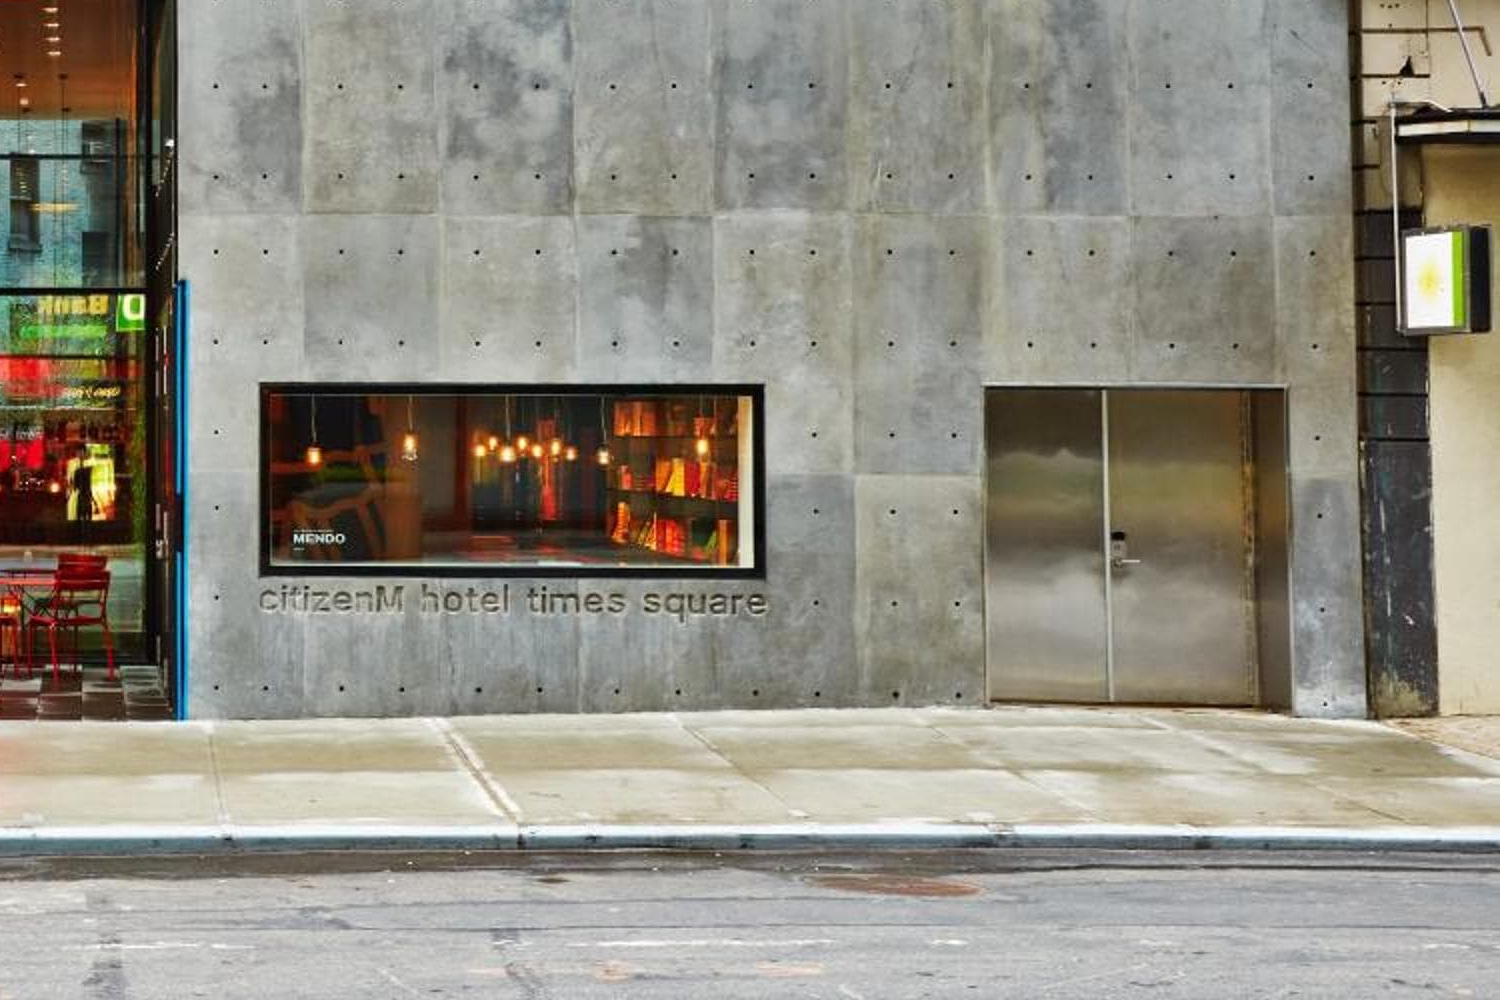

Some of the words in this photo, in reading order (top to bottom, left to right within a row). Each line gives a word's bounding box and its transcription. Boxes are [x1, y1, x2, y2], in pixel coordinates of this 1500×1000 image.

[293, 533, 346, 545] MENDO
[259, 585, 405, 613] citizenM
[421, 583, 510, 613] hotel
[526, 585, 626, 614] times
[642, 591, 768, 624] square
